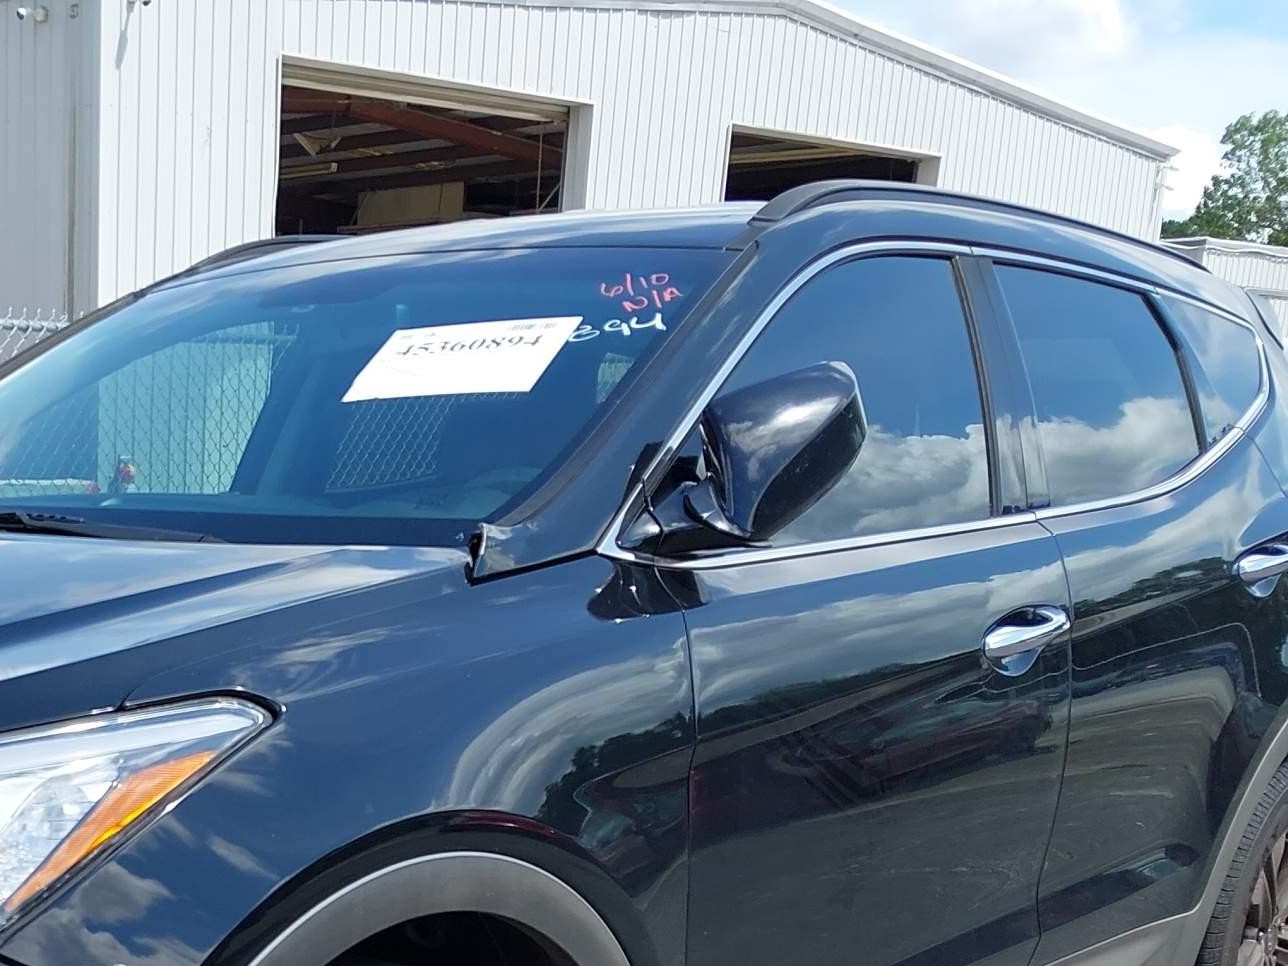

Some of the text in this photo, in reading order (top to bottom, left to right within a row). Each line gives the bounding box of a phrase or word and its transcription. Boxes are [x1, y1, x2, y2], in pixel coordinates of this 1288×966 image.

[600, 273, 669, 298] 6/10
[622, 287, 683, 312] N/A
[396, 334, 544, 356] 45360894
